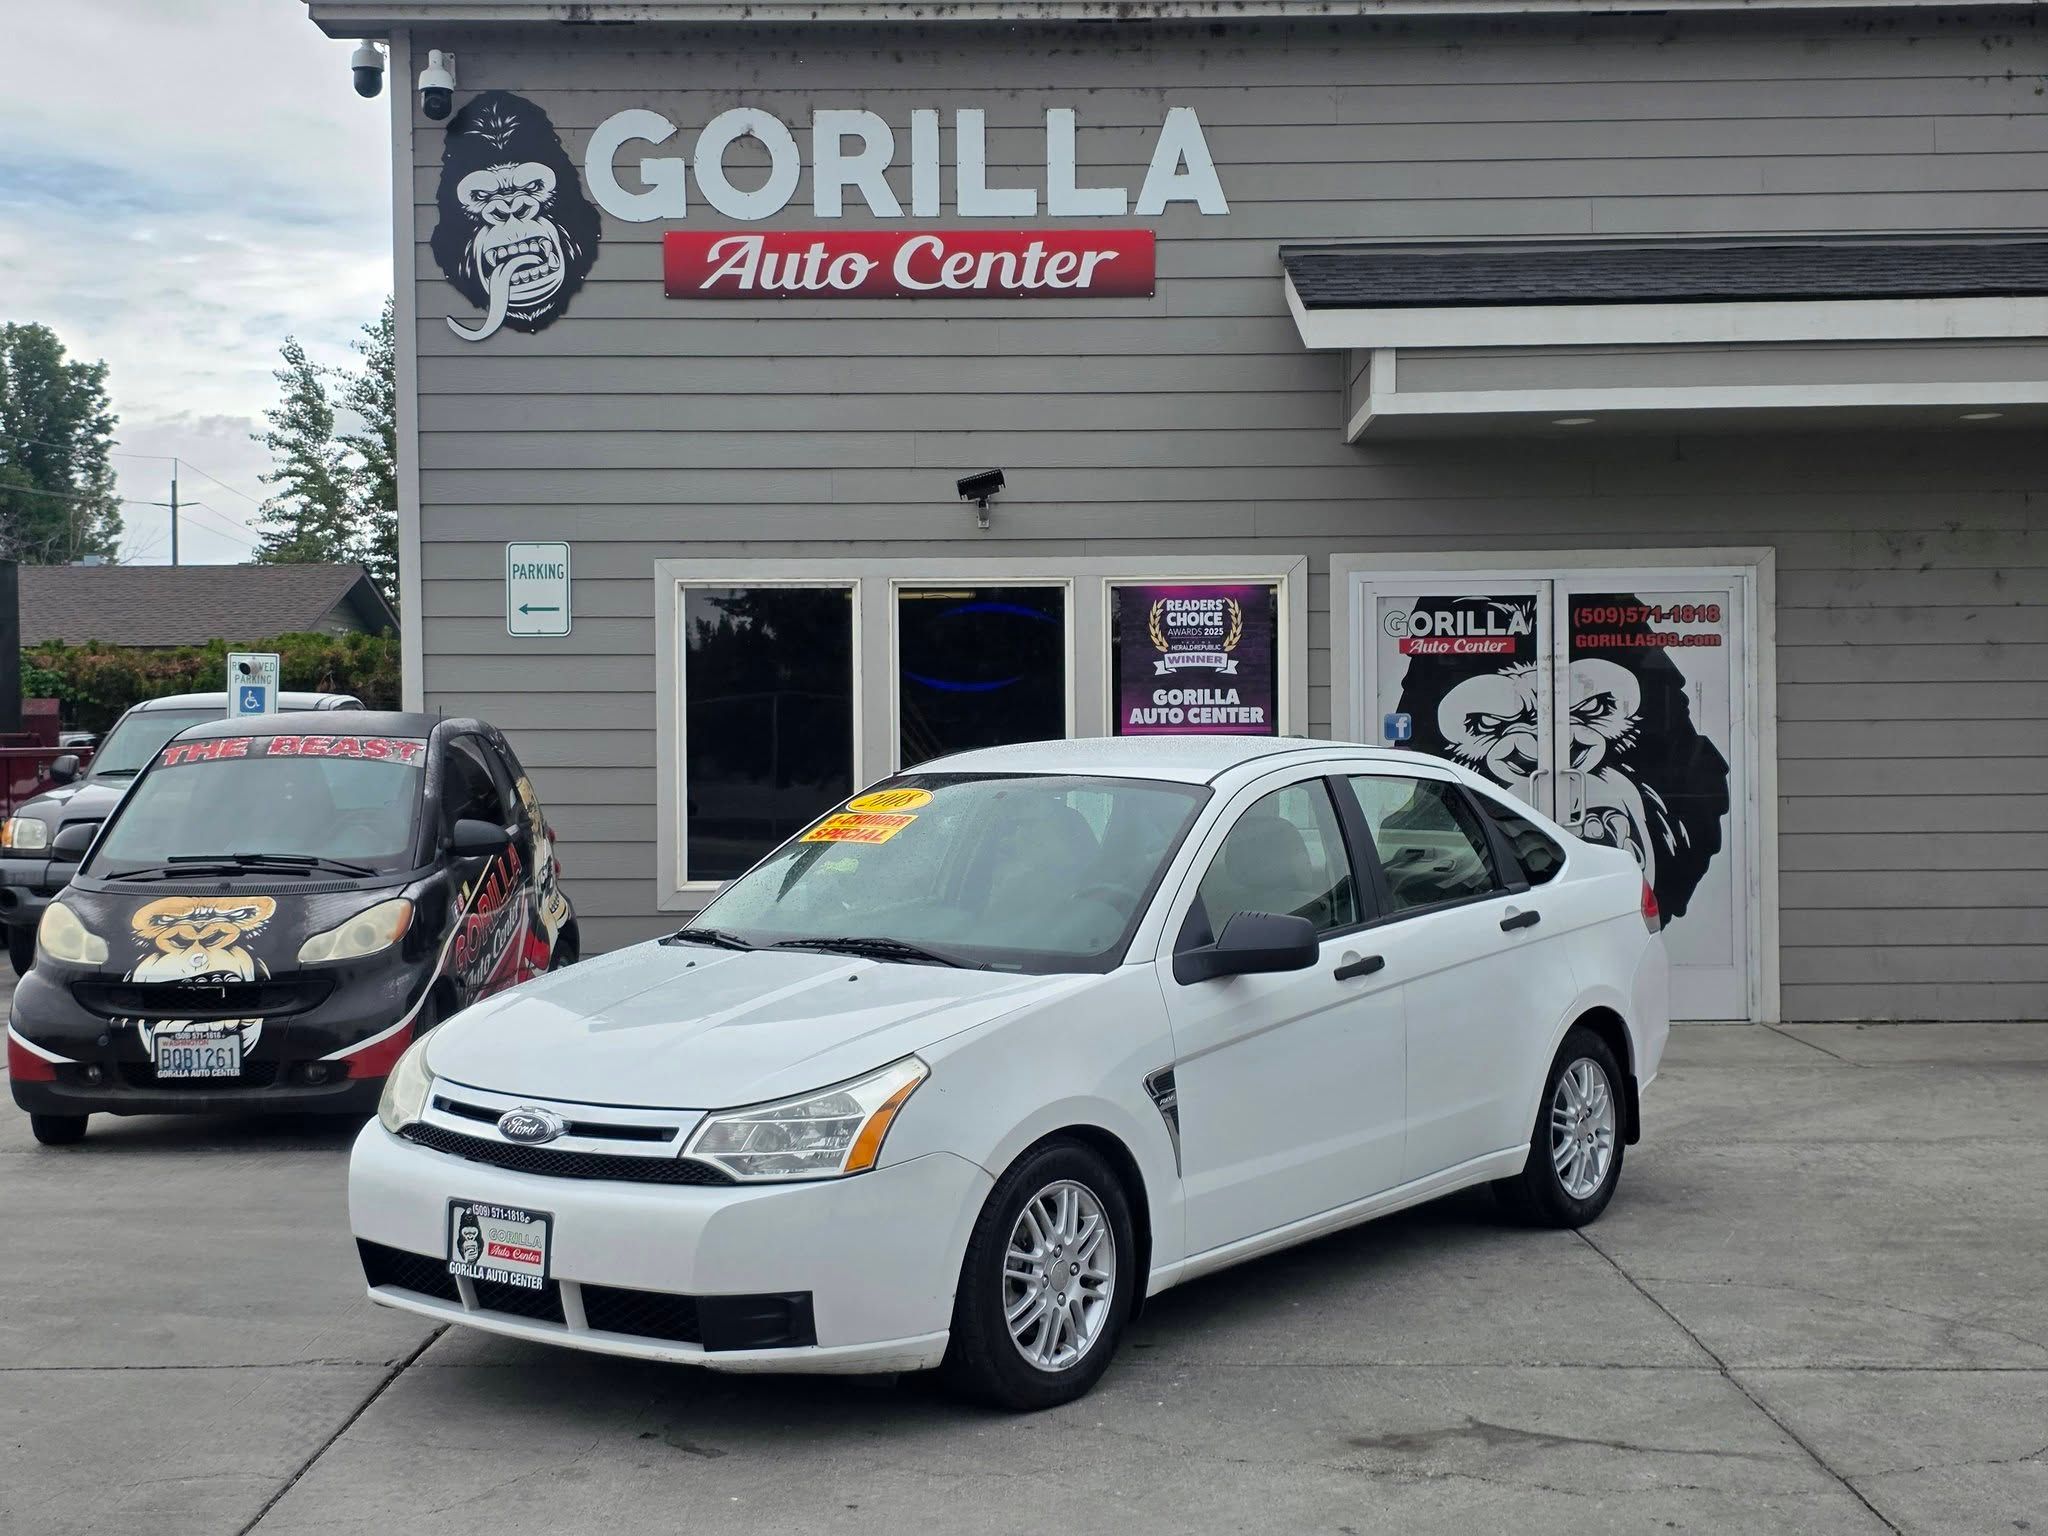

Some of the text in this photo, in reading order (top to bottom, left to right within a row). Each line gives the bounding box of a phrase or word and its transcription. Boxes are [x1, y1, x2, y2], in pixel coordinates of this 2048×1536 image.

[584, 107, 1231, 222] GORILLA
[698, 234, 1119, 291] Auto Center
[512, 563, 564, 580] PARKING
[1166, 599, 1226, 611] READERS'
[1166, 612, 1224, 626] CHOICE
[1383, 609, 1533, 638] GORILLA
[1573, 604, 1722, 628] (509)571-1818
[1167, 627, 1224, 636] AWARDS 2025
[1409, 638, 1507, 654] Auto Center
[231, 661, 275, 672] RVED
[1167, 655, 1223, 665] WINNER
[234, 674, 272, 685] PARKING
[1153, 688, 1240, 706] GORILLA
[1129, 707, 1264, 724] AUTO CENTER
[161, 735, 427, 767] THE BEAST
[808, 827, 889, 842] SPECIAL
[162, 1039, 209, 1047] WASHINGTON
[190, 1069, 210, 1078] AUTO
[211, 1068, 240, 1077] CENTER
[508, 1116, 542, 1136] Ford
[472, 1203, 525, 1223] (509) 571-1818
[488, 1228, 542, 1249] GORILLA
[512, 1248, 541, 1263] Center
[486, 1268, 509, 1284] AUTO
[510, 1272, 543, 1291] CENTER
